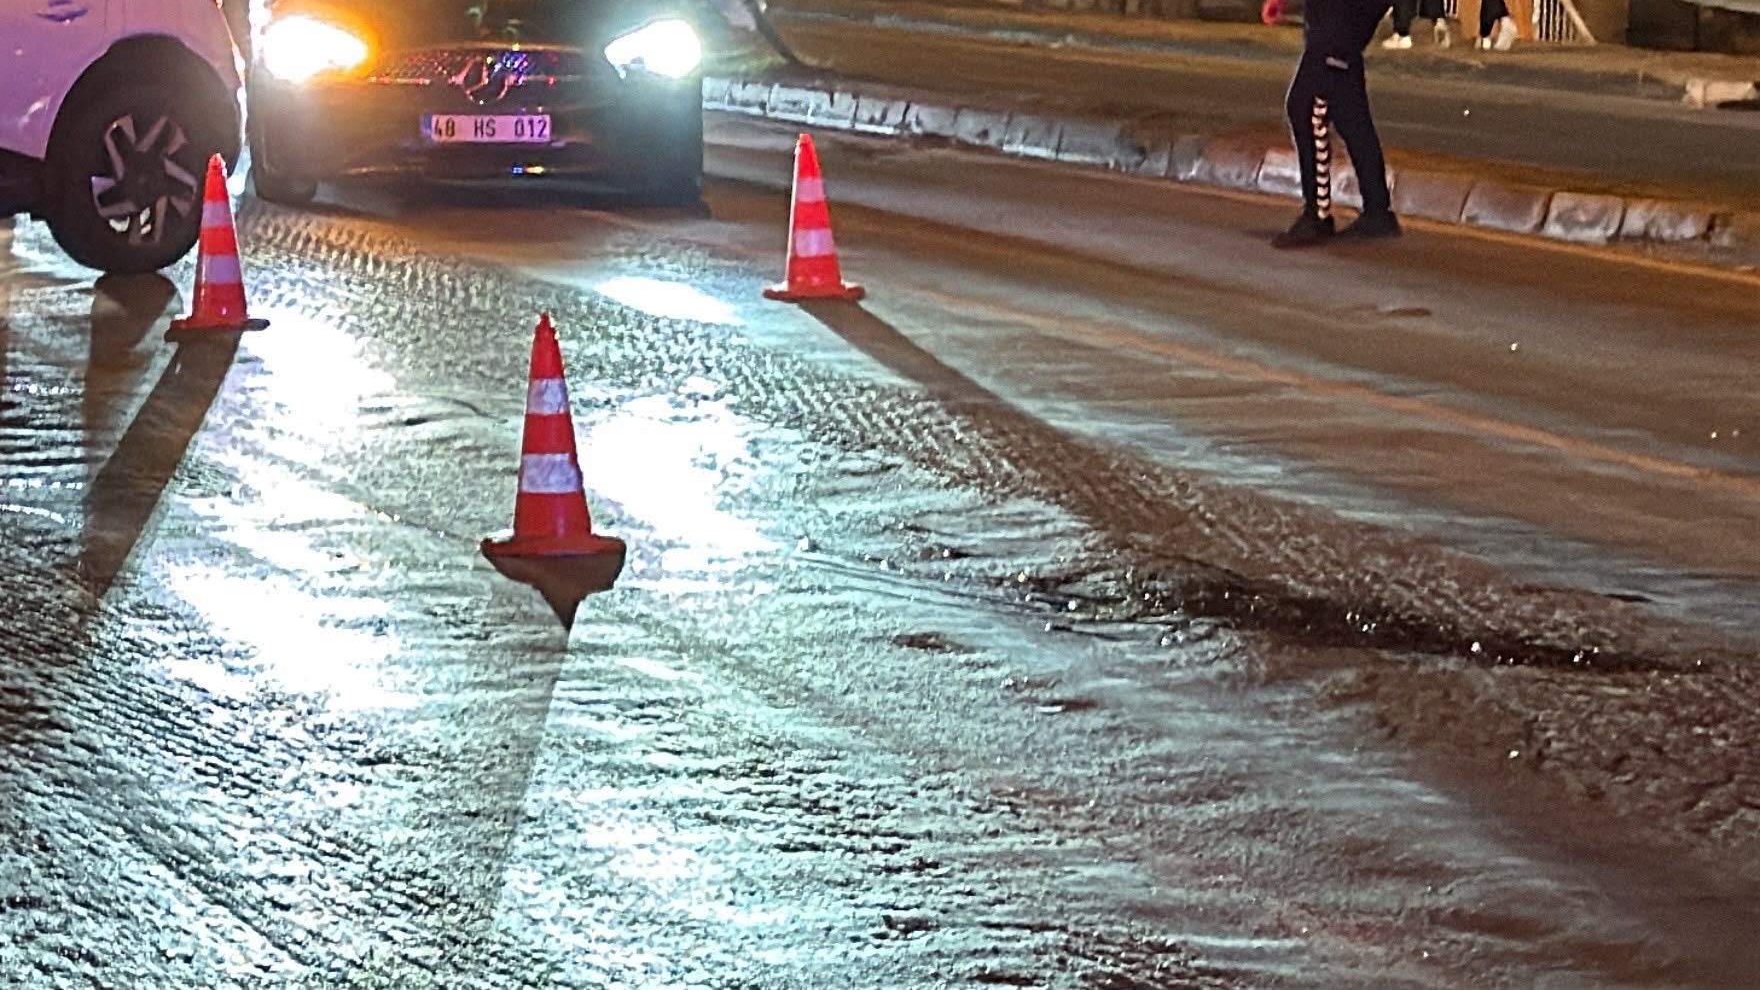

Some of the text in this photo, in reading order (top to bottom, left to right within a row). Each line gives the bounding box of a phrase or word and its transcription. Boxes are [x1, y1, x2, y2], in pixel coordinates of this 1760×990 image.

[434, 117, 548, 139] 48 HS 012
